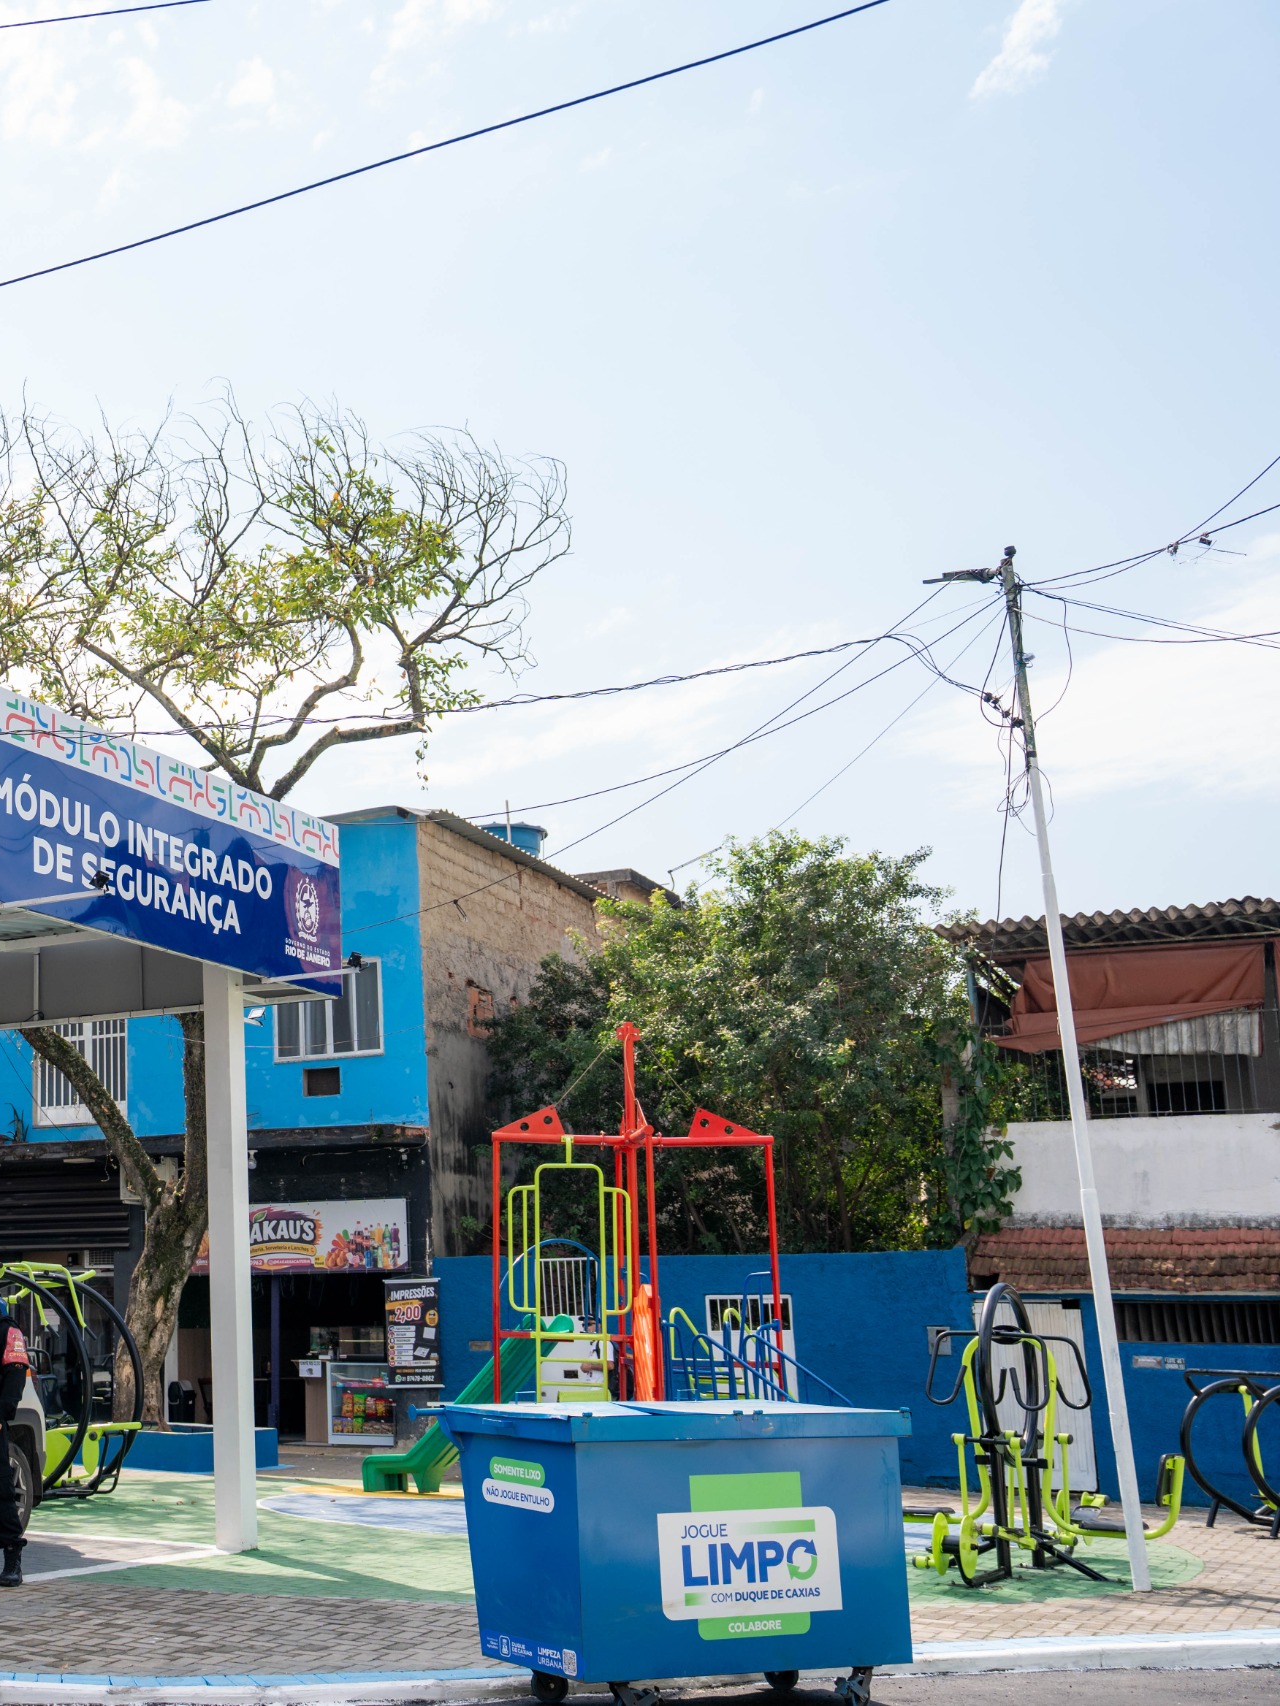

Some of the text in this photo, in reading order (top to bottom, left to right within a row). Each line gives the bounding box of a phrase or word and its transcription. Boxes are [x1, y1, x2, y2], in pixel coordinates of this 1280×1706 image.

[128, 819, 272, 900] INTEGRADO
[33, 835, 241, 935] DE SEGURANÇA
[285, 937, 306, 949] GOVERNO
[285, 944, 331, 968] RIO DE JANEIRO
[250, 1219, 315, 1244] AKAU'S
[390, 1286, 435, 1301] IMPRESSÕES
[395, 1305, 421, 1325] 2,00
[493, 1463, 541, 1480] SOMENTE LIXO
[486, 1485, 550, 1507] NÃO JOGUE ENTULHO
[681, 1523, 728, 1539] JOGUE
[710, 1586, 821, 1603] COM DUQUE DE CAXIAS
[728, 1619, 782, 1633] COLABORE
[537, 1646, 562, 1659] LIMPEZA
[537, 1656, 563, 1670] URBANA
